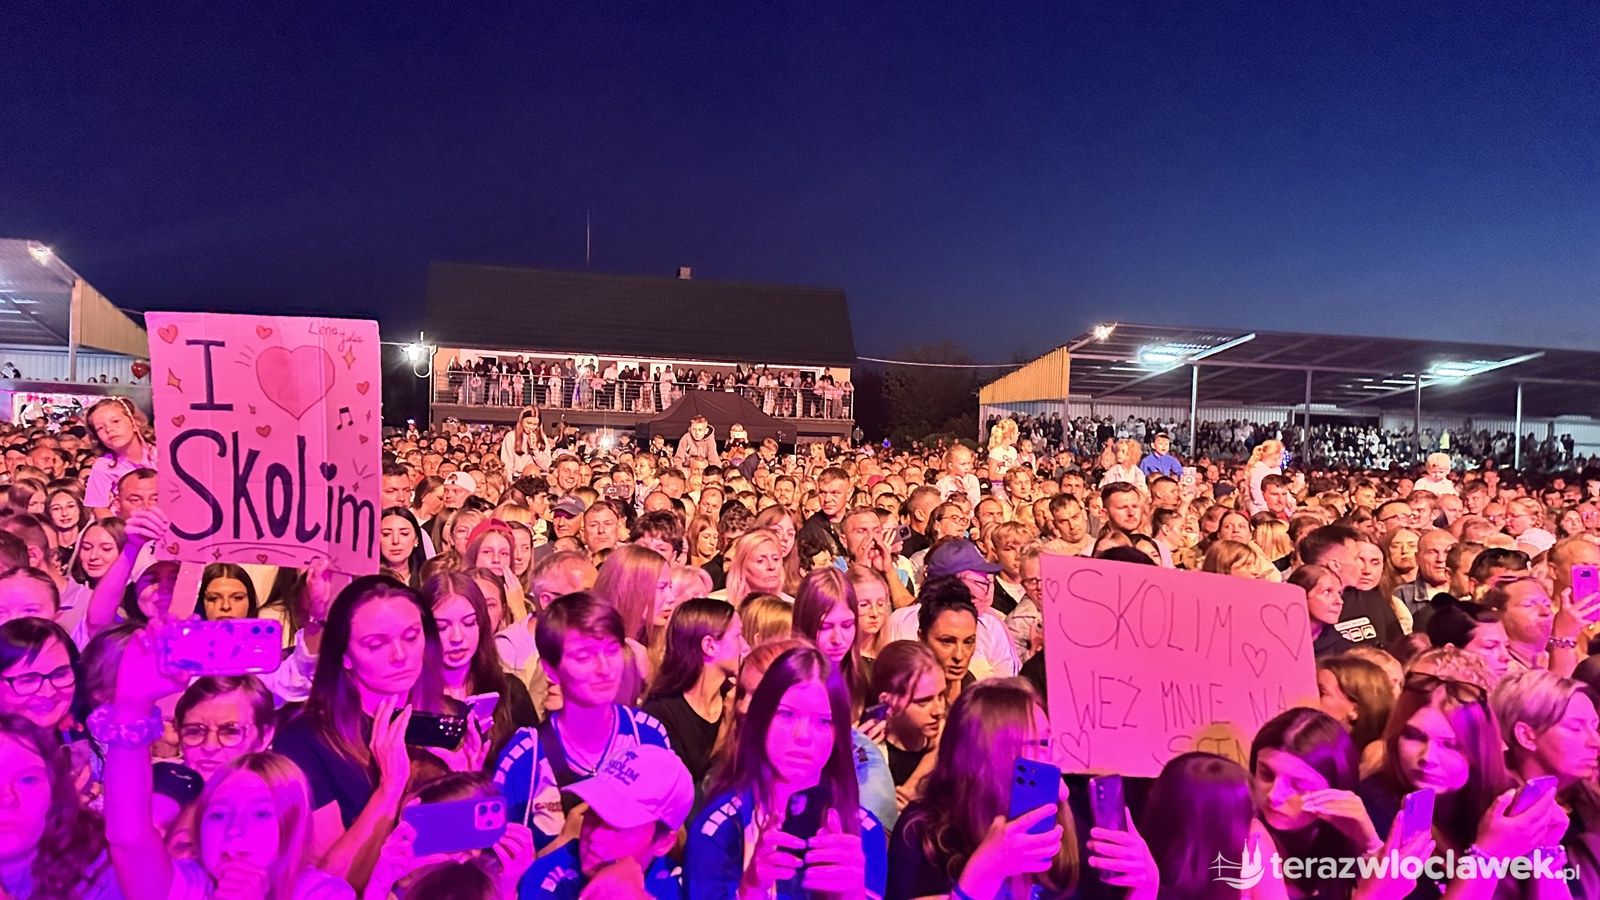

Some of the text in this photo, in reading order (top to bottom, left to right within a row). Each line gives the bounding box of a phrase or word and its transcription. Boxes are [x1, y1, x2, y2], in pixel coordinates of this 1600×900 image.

[186, 339, 234, 412] I
[1059, 568, 1232, 667] SKOLIM
[1160, 681, 1230, 732] MNIE
[1248, 685, 1287, 727] NA
